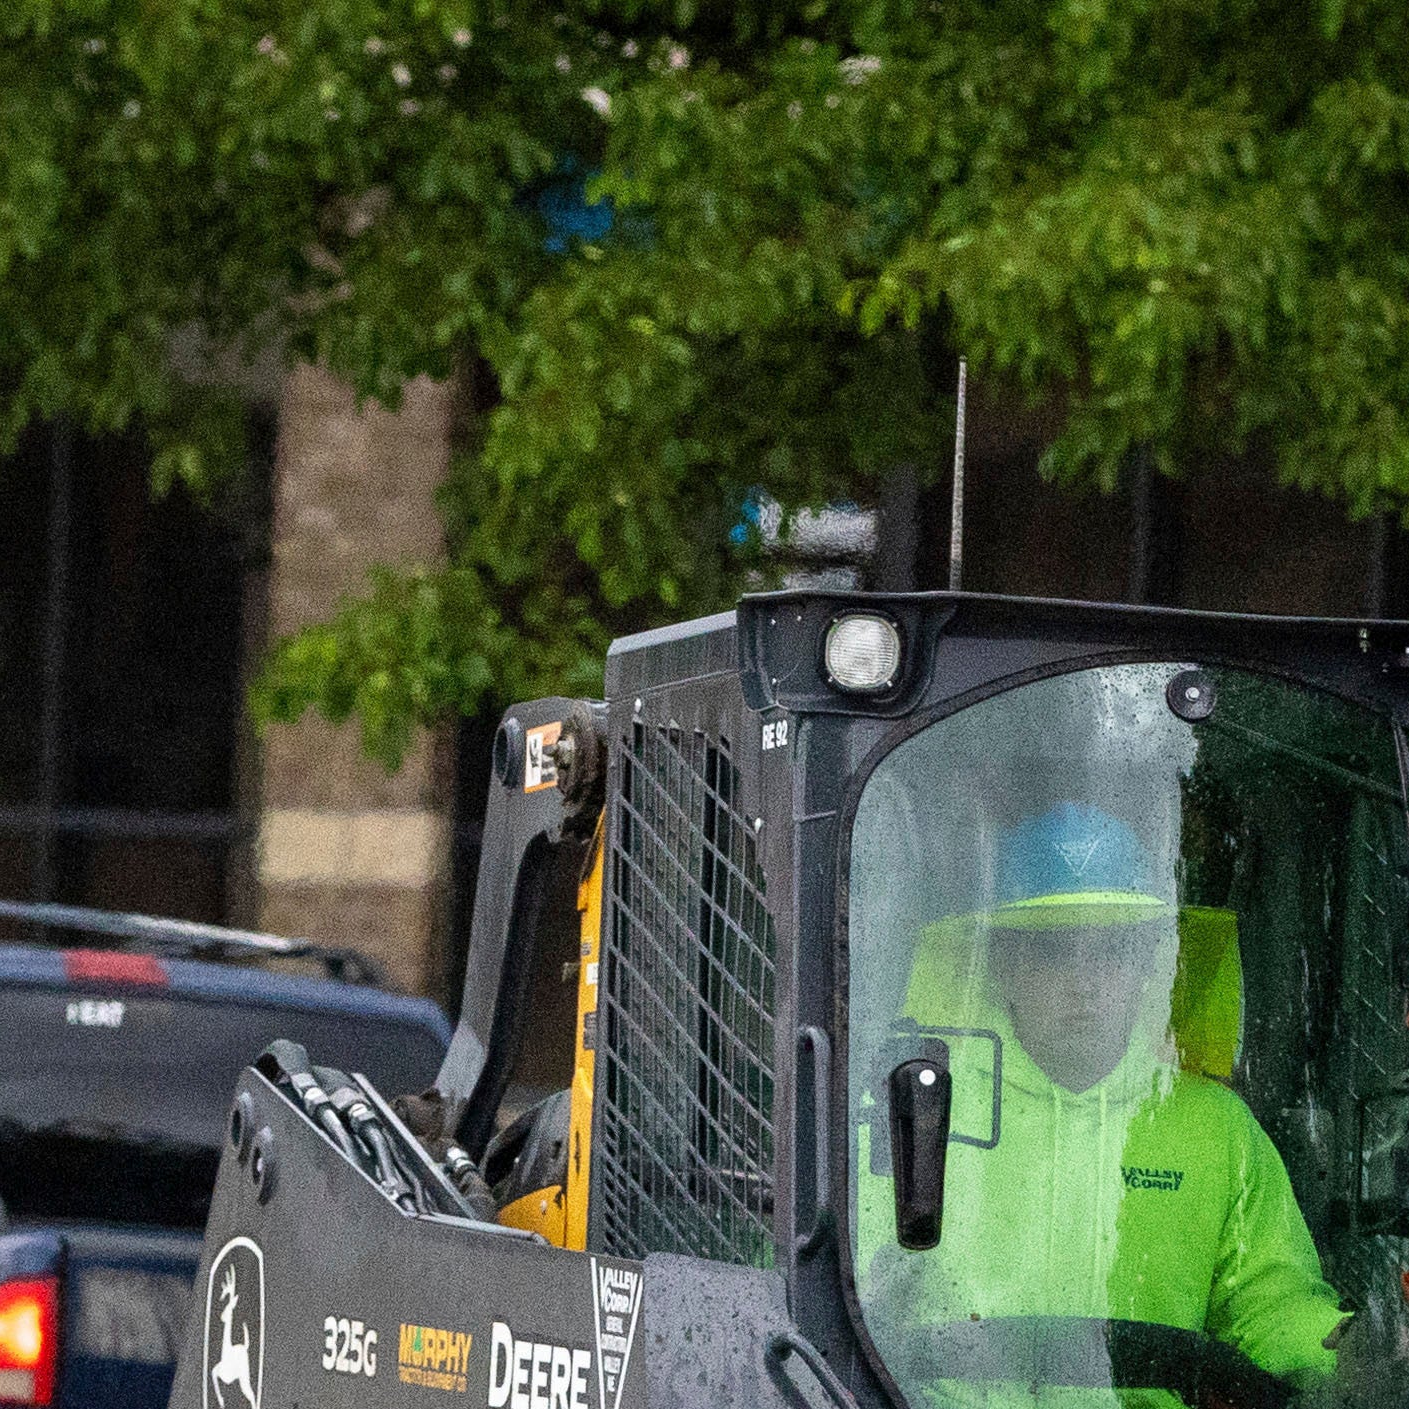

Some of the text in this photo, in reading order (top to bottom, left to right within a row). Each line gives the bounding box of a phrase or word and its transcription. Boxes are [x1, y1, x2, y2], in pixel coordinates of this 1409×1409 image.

[599, 1266, 638, 1314] VALLEY
[322, 1315, 378, 1377] 325G
[398, 1323, 473, 1374] MURPHY
